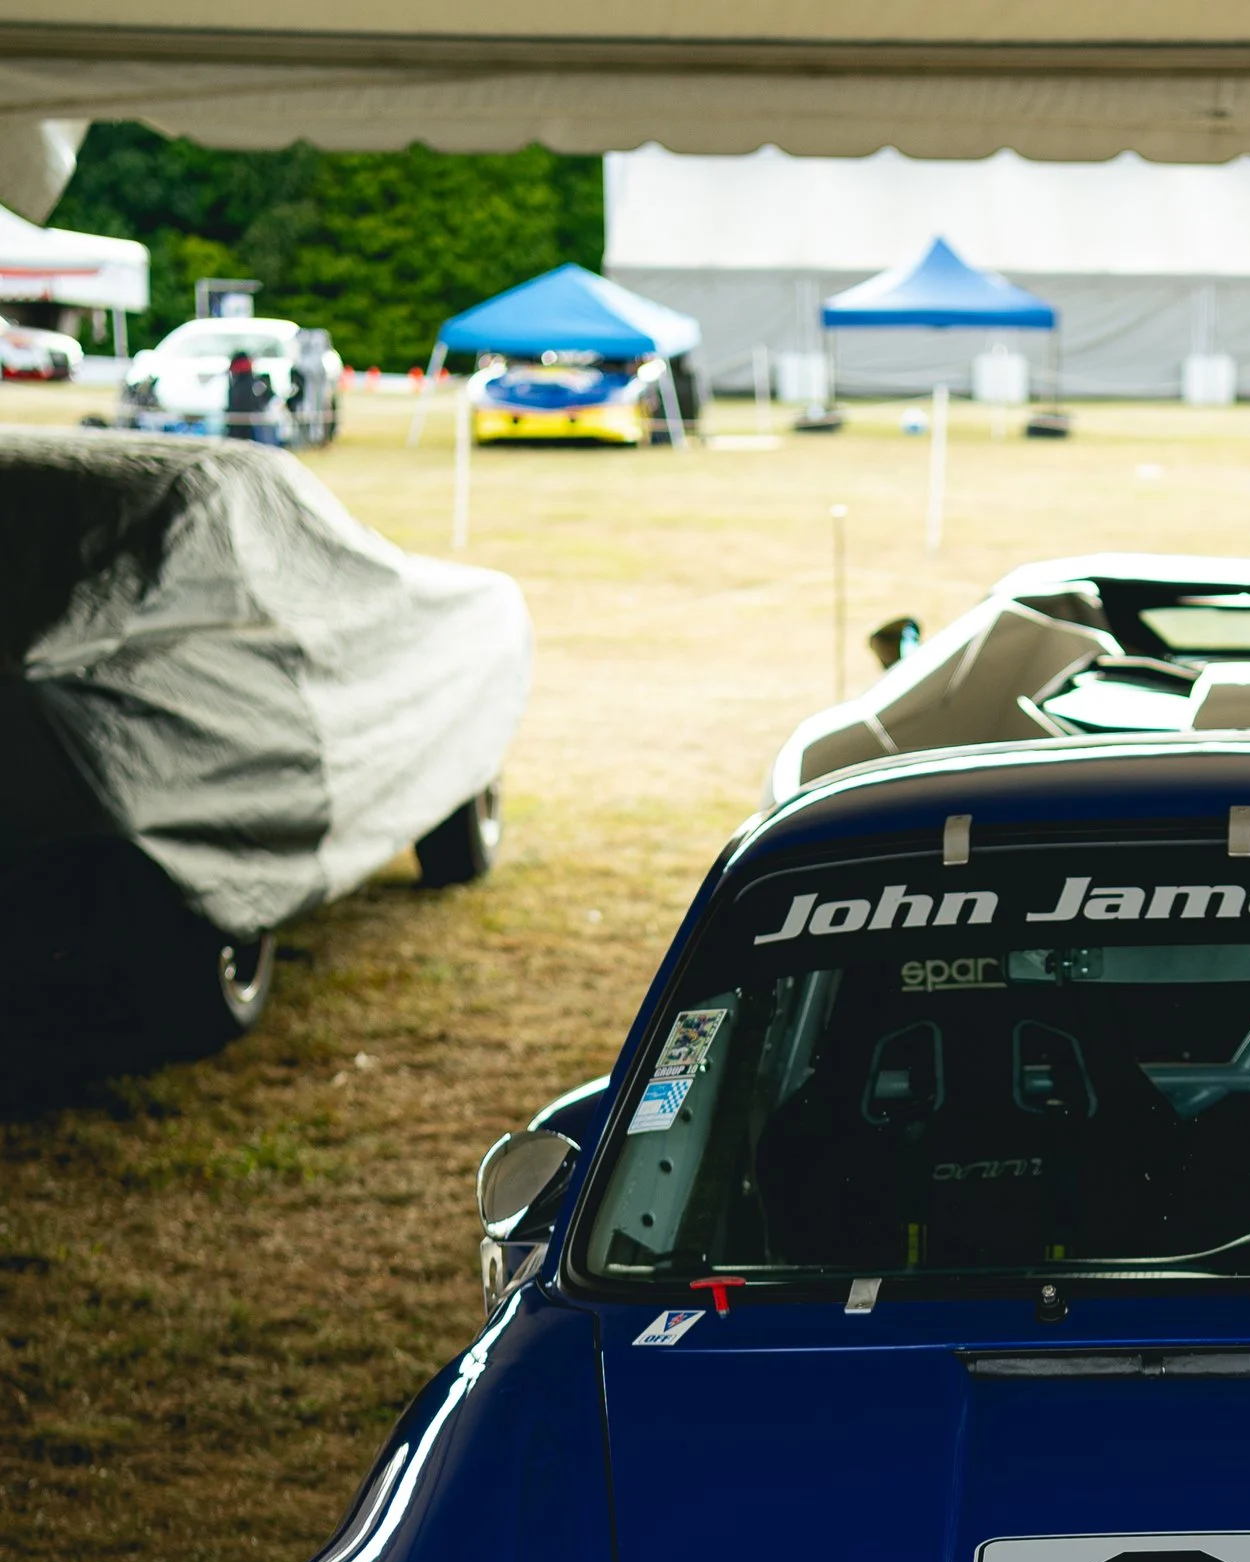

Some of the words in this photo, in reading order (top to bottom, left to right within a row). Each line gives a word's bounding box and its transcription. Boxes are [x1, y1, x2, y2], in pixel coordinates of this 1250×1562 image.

[754, 885, 999, 946] John
[901, 957, 1010, 992] spar
[654, 1066, 685, 1078] GROUP
[644, 1334, 671, 1344] OFF
